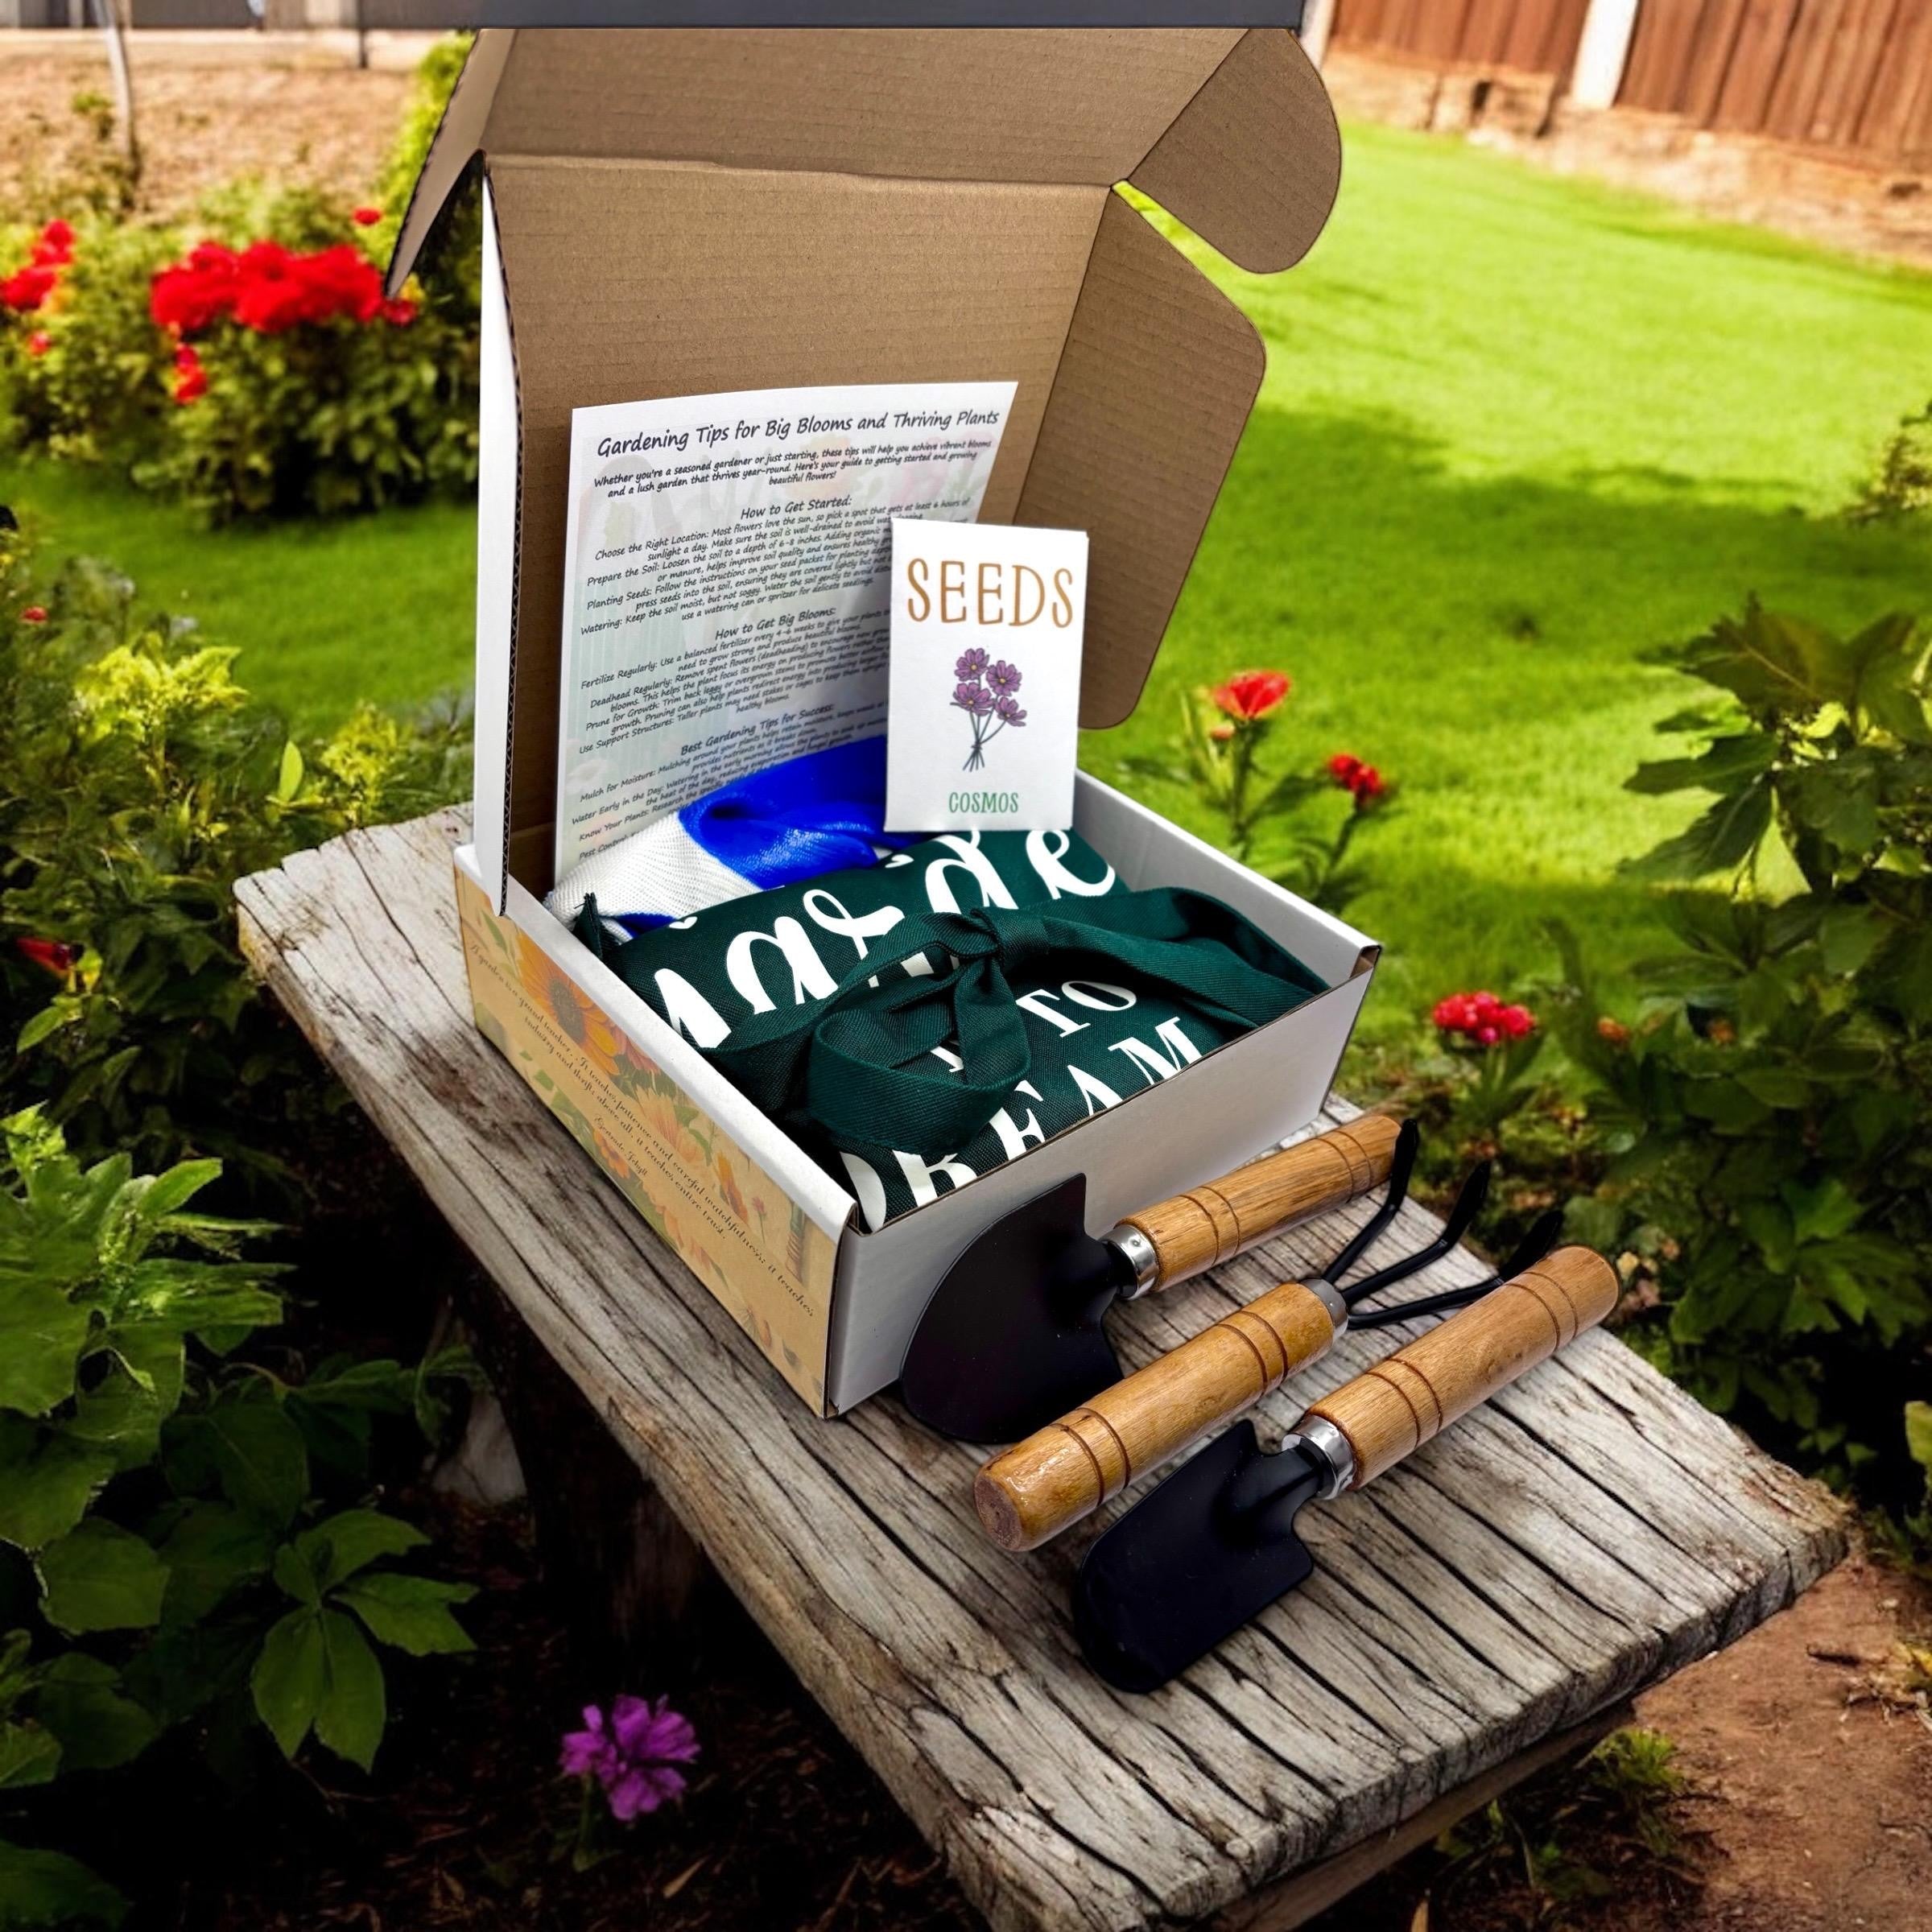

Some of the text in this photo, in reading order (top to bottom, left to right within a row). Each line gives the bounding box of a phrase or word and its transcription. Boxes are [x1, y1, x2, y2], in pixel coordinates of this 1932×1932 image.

[597, 407, 999, 457] Gardening Tips for Big Blooms and Thriving Plants
[594, 473, 634, 487] Whether
[635, 469, 663, 484] you're
[666, 468, 671, 476] a
[674, 460, 712, 475] seasoned
[713, 456, 753, 473] gardener
[754, 456, 764, 464] or
[764, 452, 782, 465] just
[822, 448, 841, 457] these
[844, 446, 859, 458] tips
[608, 485, 625, 497] and
[628, 486, 634, 494] a
[637, 481, 654, 493] lush
[657, 477, 687, 493] garden
[691, 473, 708, 485] that
[712, 469, 740, 481] thrives
[794, 460, 819, 472] Here's
[821, 460, 840, 472] your
[840, 454, 862, 470] guide
[769, 472, 803, 485] beautiful
[741, 493, 852, 520] How to Get Started:
[595, 547, 625, 560] Choose
[628, 542, 642, 553] the
[645, 537, 669, 551] Right
[711, 526, 732, 537] Most
[733, 522, 762, 534] flowers
[647, 546, 681, 561] sunlight
[683, 546, 688, 554] a
[711, 536, 733, 548] Make
[735, 535, 752, 544] sure
[754, 530, 767, 541] the
[587, 572, 621, 586] Prepare
[625, 567, 638, 578] the
[662, 558, 690, 570] Loosen
[692, 552, 706, 564] the
[708, 548, 723, 560] soil
[724, 548, 733, 557] to
[742, 541, 766, 555] depth
[657, 573, 667, 582] or
[706, 559, 726, 572] helps
[587, 594, 623, 610] Planting
[654, 581, 681, 594] Follow
[683, 577, 696, 588] the
[699, 568, 745, 584] instructions
[635, 597, 657, 612] press
[659, 591, 681, 605] seeds
[683, 588, 700, 598] into
[702, 584, 715, 594] the
[906, 558, 1073, 629] SEEDS
[625, 612, 646, 624] Keep
[648, 607, 662, 618] the
[664, 601, 678, 614] soil
[681, 611, 694, 621] use
[704, 601, 739, 615] watering
[715, 607, 836, 640] How to Get Big Blooms:
[680, 712, 796, 756] Best Gardening Tips for
[948, 791, 1020, 815] COSMOS
[1015, 980, 1137, 1038] TO
[556, 1051, 573, 1071] and
[597, 1095, 620, 1121] above
[644, 1146, 675, 1182] teaches
[675, 1181, 703, 1211] entire
[615, 1100, 652, 1139] patience
[653, 1140, 674, 1161] and
[673, 1161, 706, 1195] careful
[777, 1275, 814, 1317] teaches
